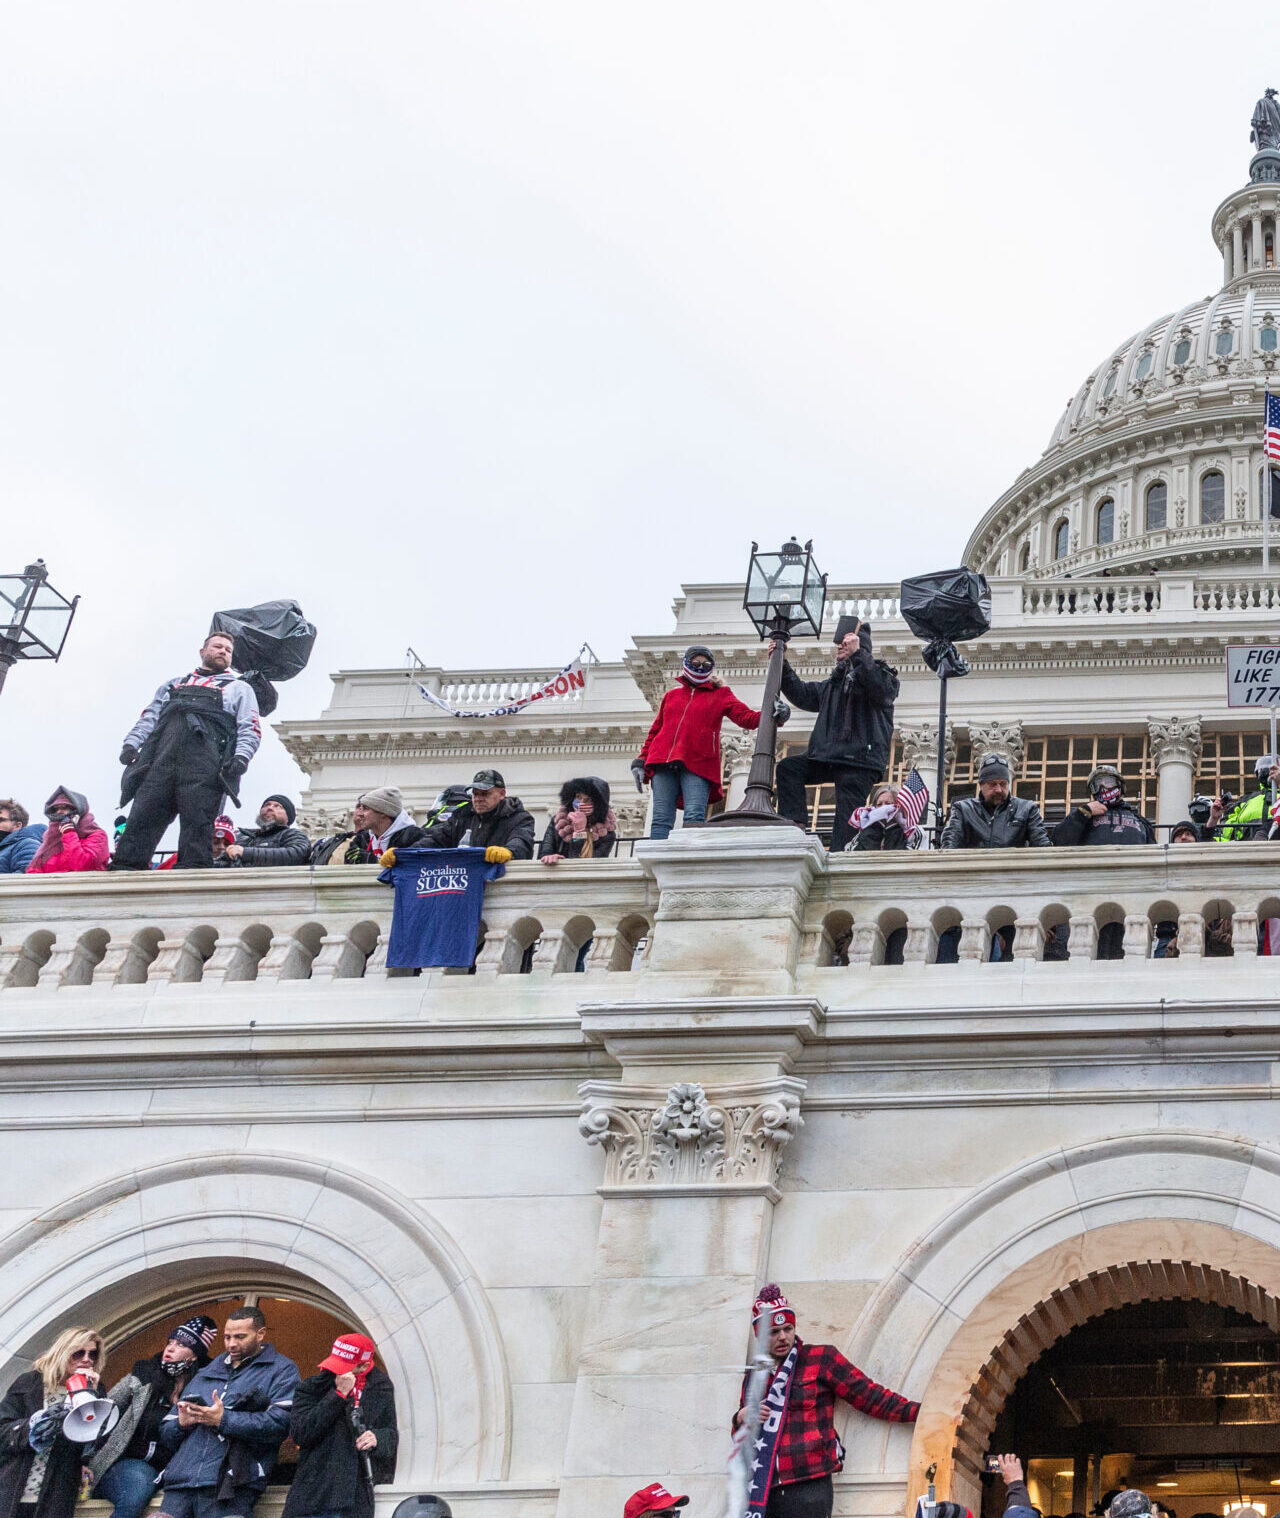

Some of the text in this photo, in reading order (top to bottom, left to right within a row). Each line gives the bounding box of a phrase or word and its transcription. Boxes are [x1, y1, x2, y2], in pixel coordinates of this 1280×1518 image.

[1234, 668, 1273, 684] LIKE
[420, 864, 467, 878] Socialism
[416, 874, 469, 892] SUCKS
